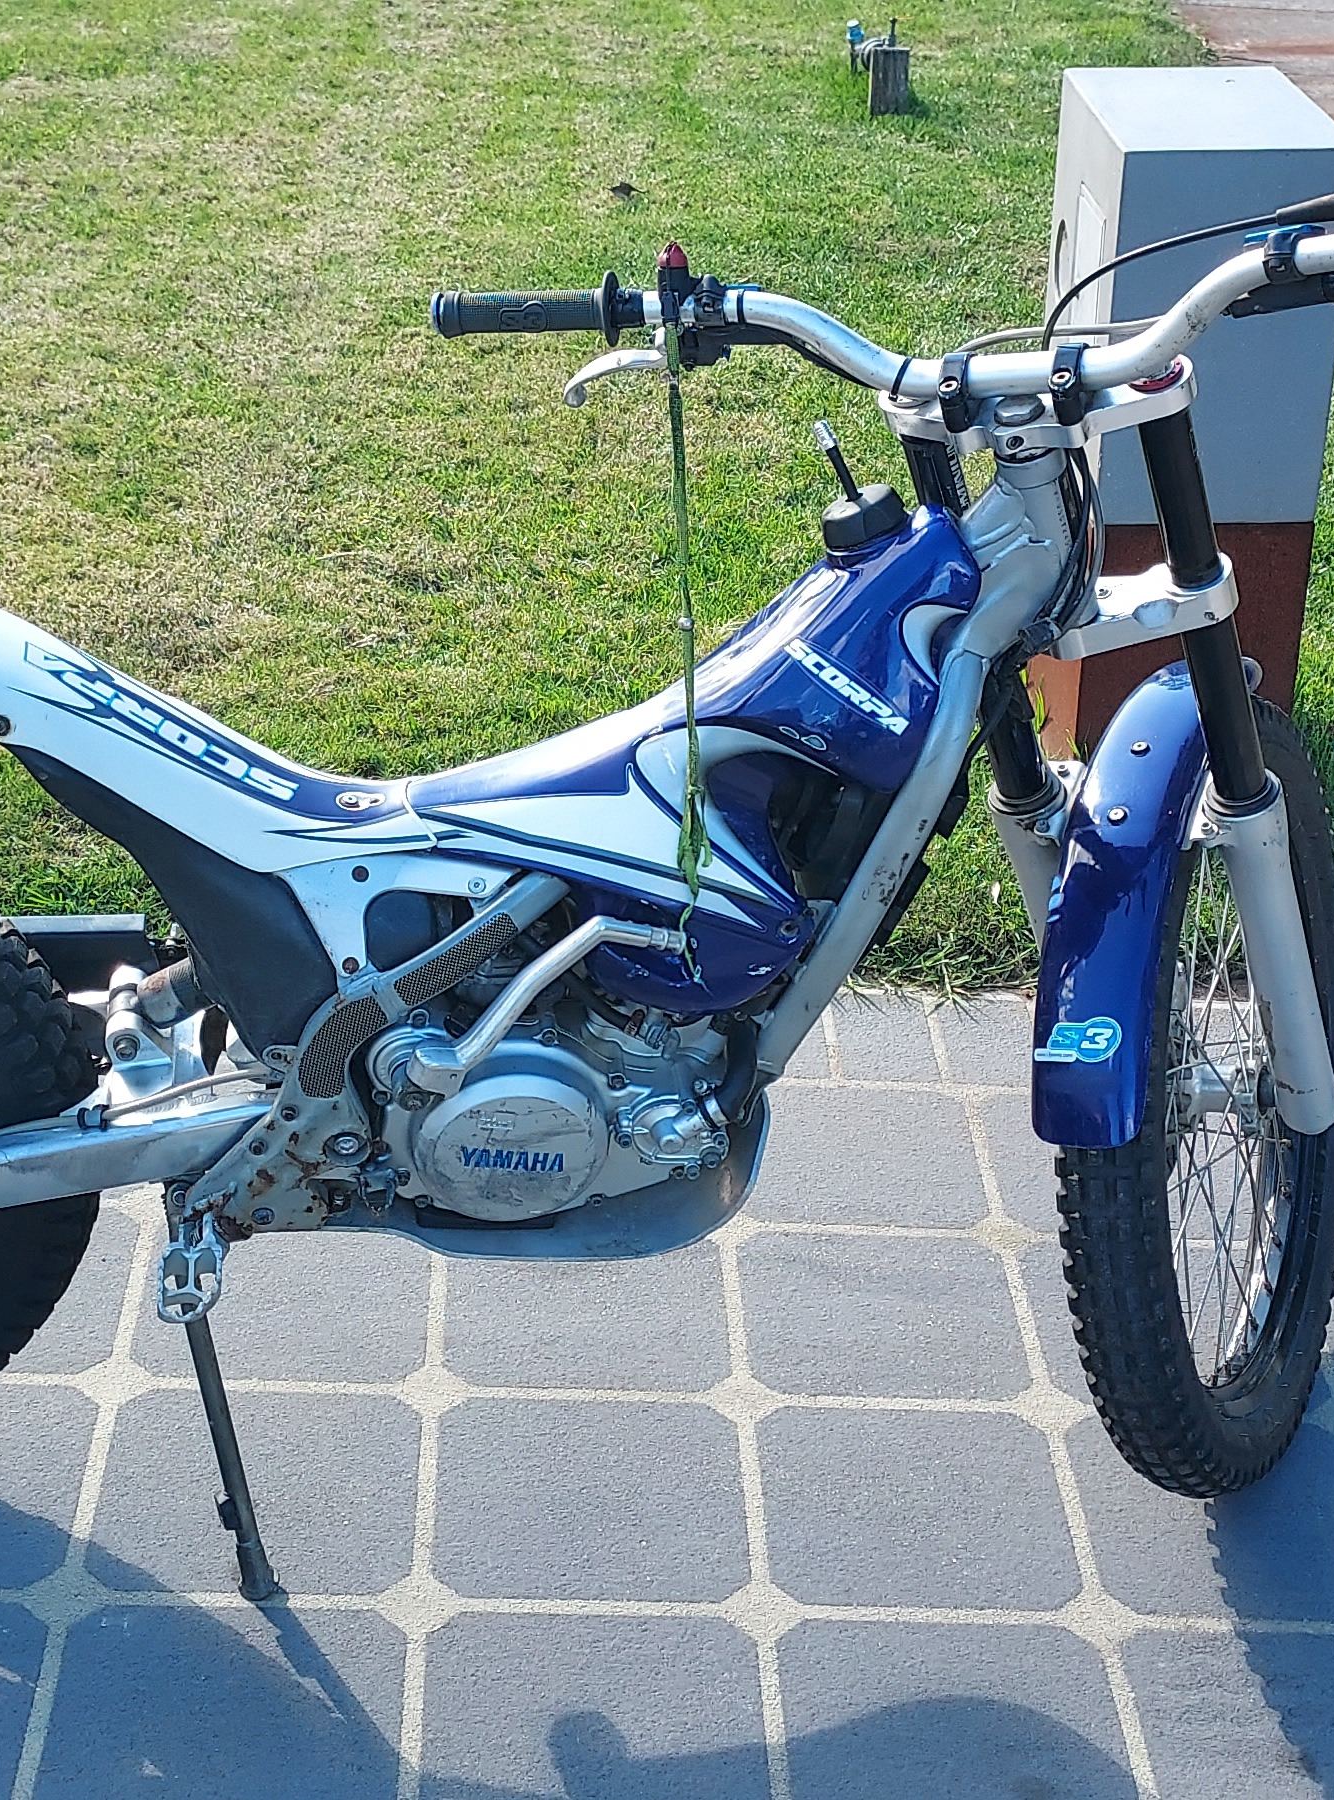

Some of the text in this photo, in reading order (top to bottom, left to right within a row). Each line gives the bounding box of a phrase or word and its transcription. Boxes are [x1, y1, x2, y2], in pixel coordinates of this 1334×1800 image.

[23, 640, 301, 802] SCORPA
[783, 637, 911, 736] SCORPA
[460, 1146, 565, 1173] YAMAHA
